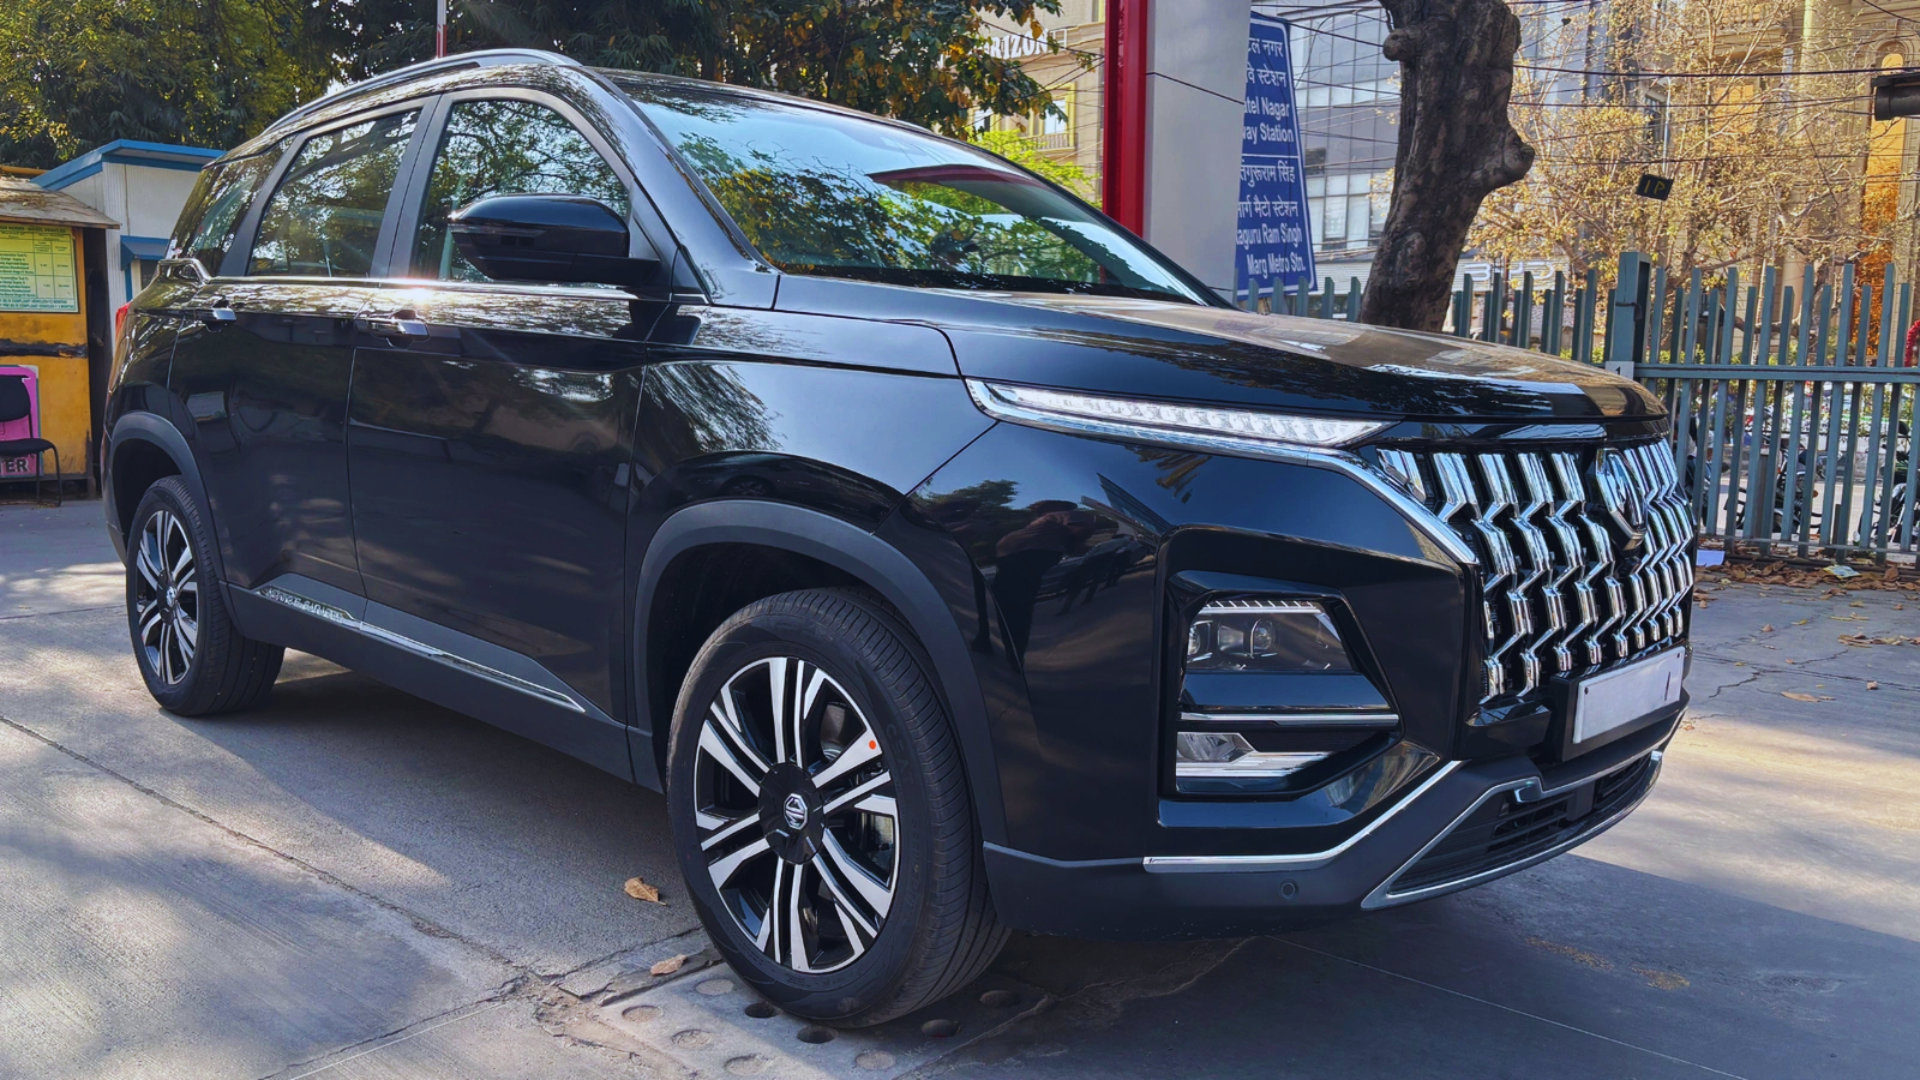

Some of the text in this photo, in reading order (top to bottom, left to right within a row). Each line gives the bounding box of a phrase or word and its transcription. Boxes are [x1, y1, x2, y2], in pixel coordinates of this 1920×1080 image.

[1261, 39, 1284, 57] नगर
[1256, 63, 1287, 88] स्टेशन
[1260, 96, 1290, 121] Nagar
[1259, 122, 1295, 143] Station
[1271, 194, 1299, 218] स्टेशन
[1261, 222, 1281, 244] Ram
[1280, 222, 1303, 248] Singh
[1246, 251, 1307, 280] Marg Metro Stn.
